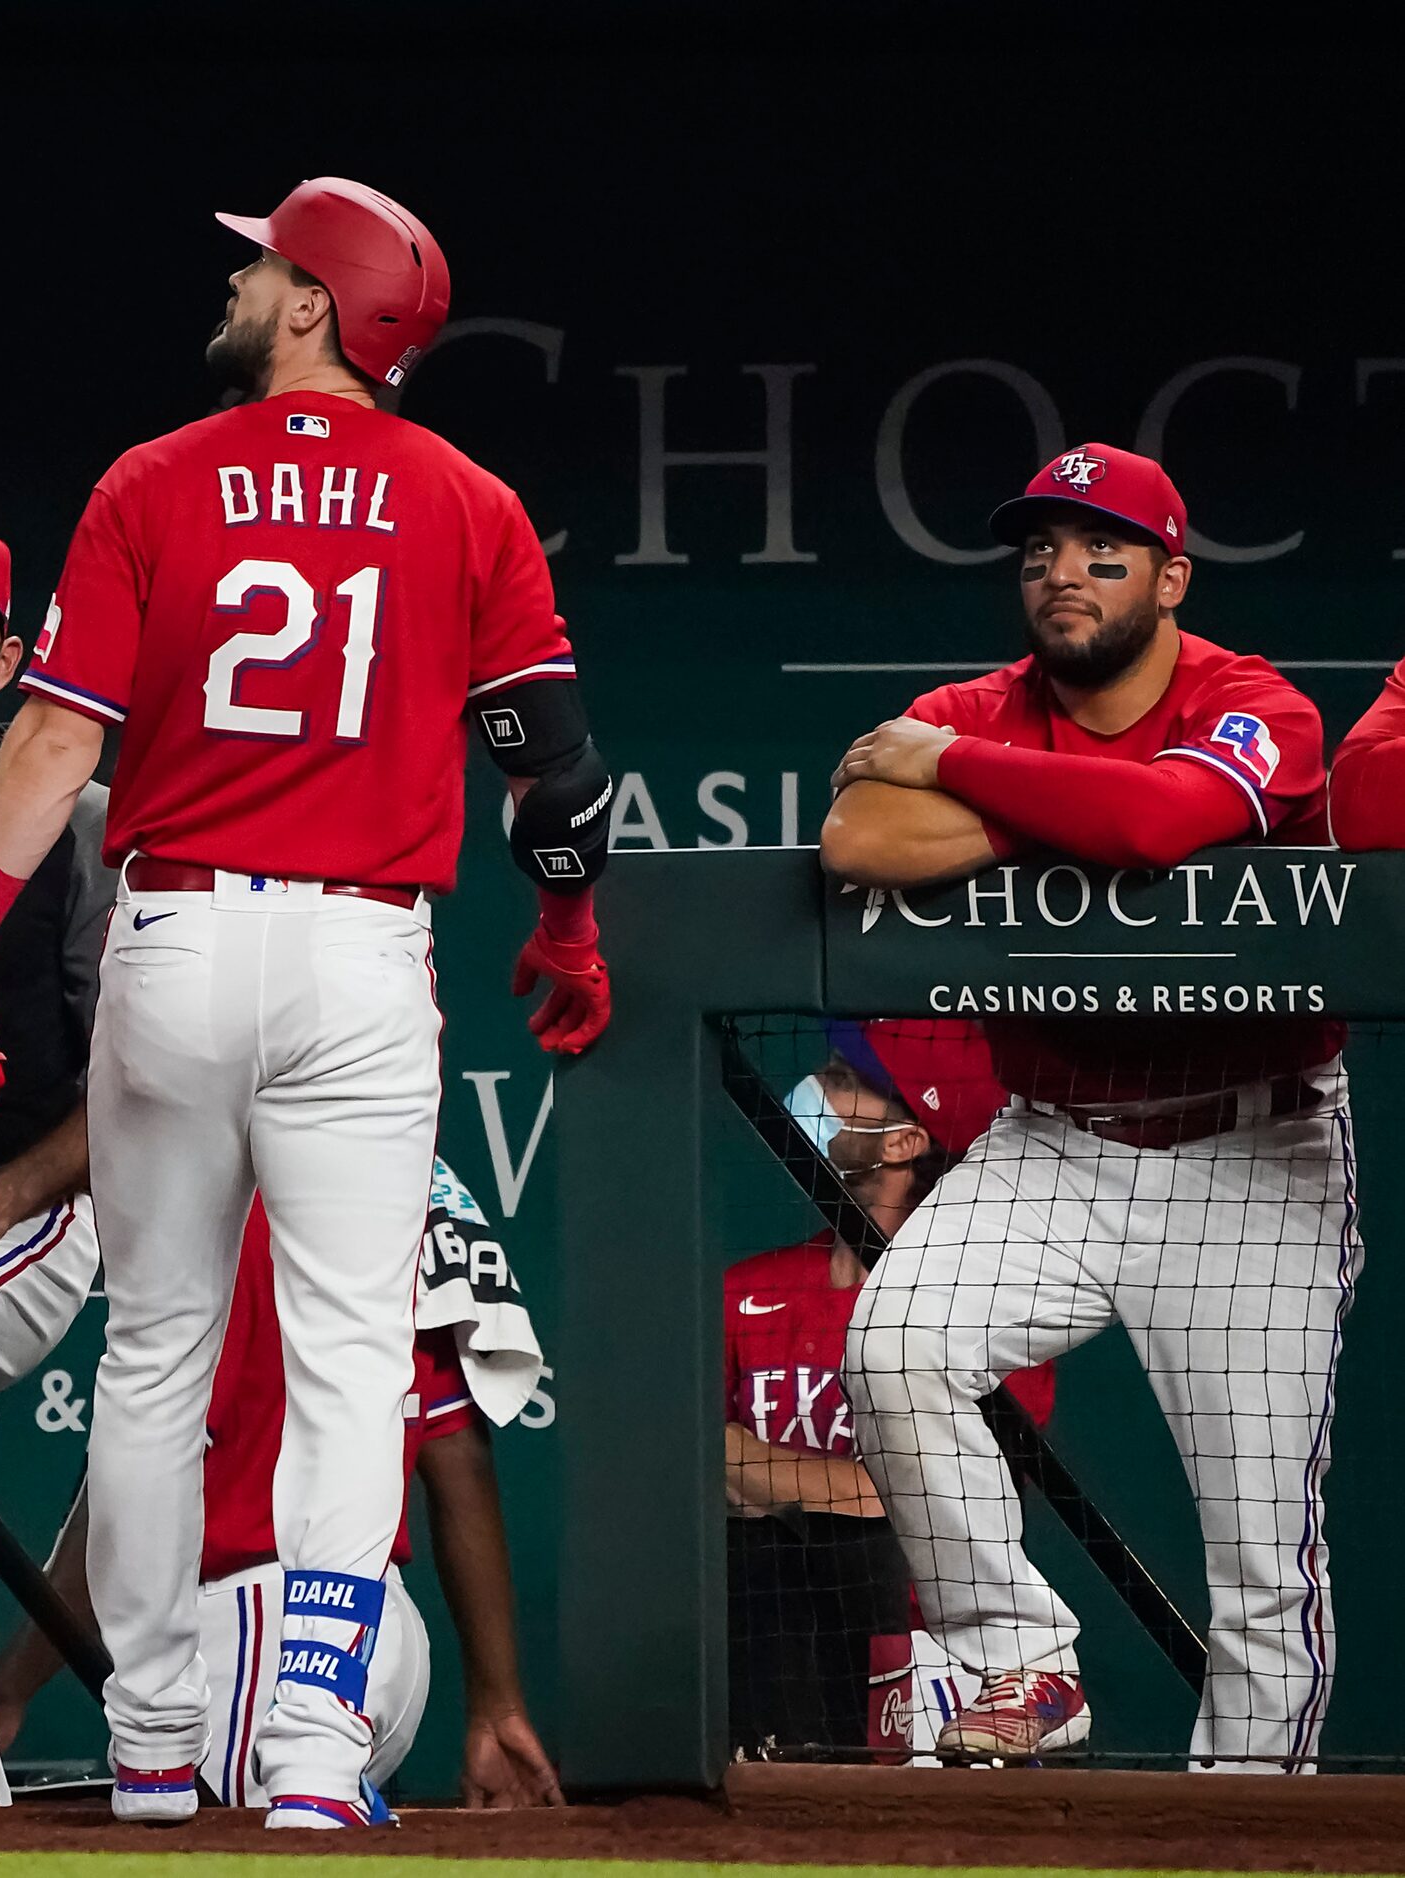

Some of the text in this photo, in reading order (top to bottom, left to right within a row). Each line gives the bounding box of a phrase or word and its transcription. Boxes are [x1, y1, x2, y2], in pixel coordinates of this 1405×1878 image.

[218, 463, 396, 532] DAHL
[203, 559, 382, 739] 21
[930, 984, 1325, 1013] CASINOS & RESORTS
[287, 1580, 356, 1610] DAHL
[279, 1650, 340, 1682] DAHL
